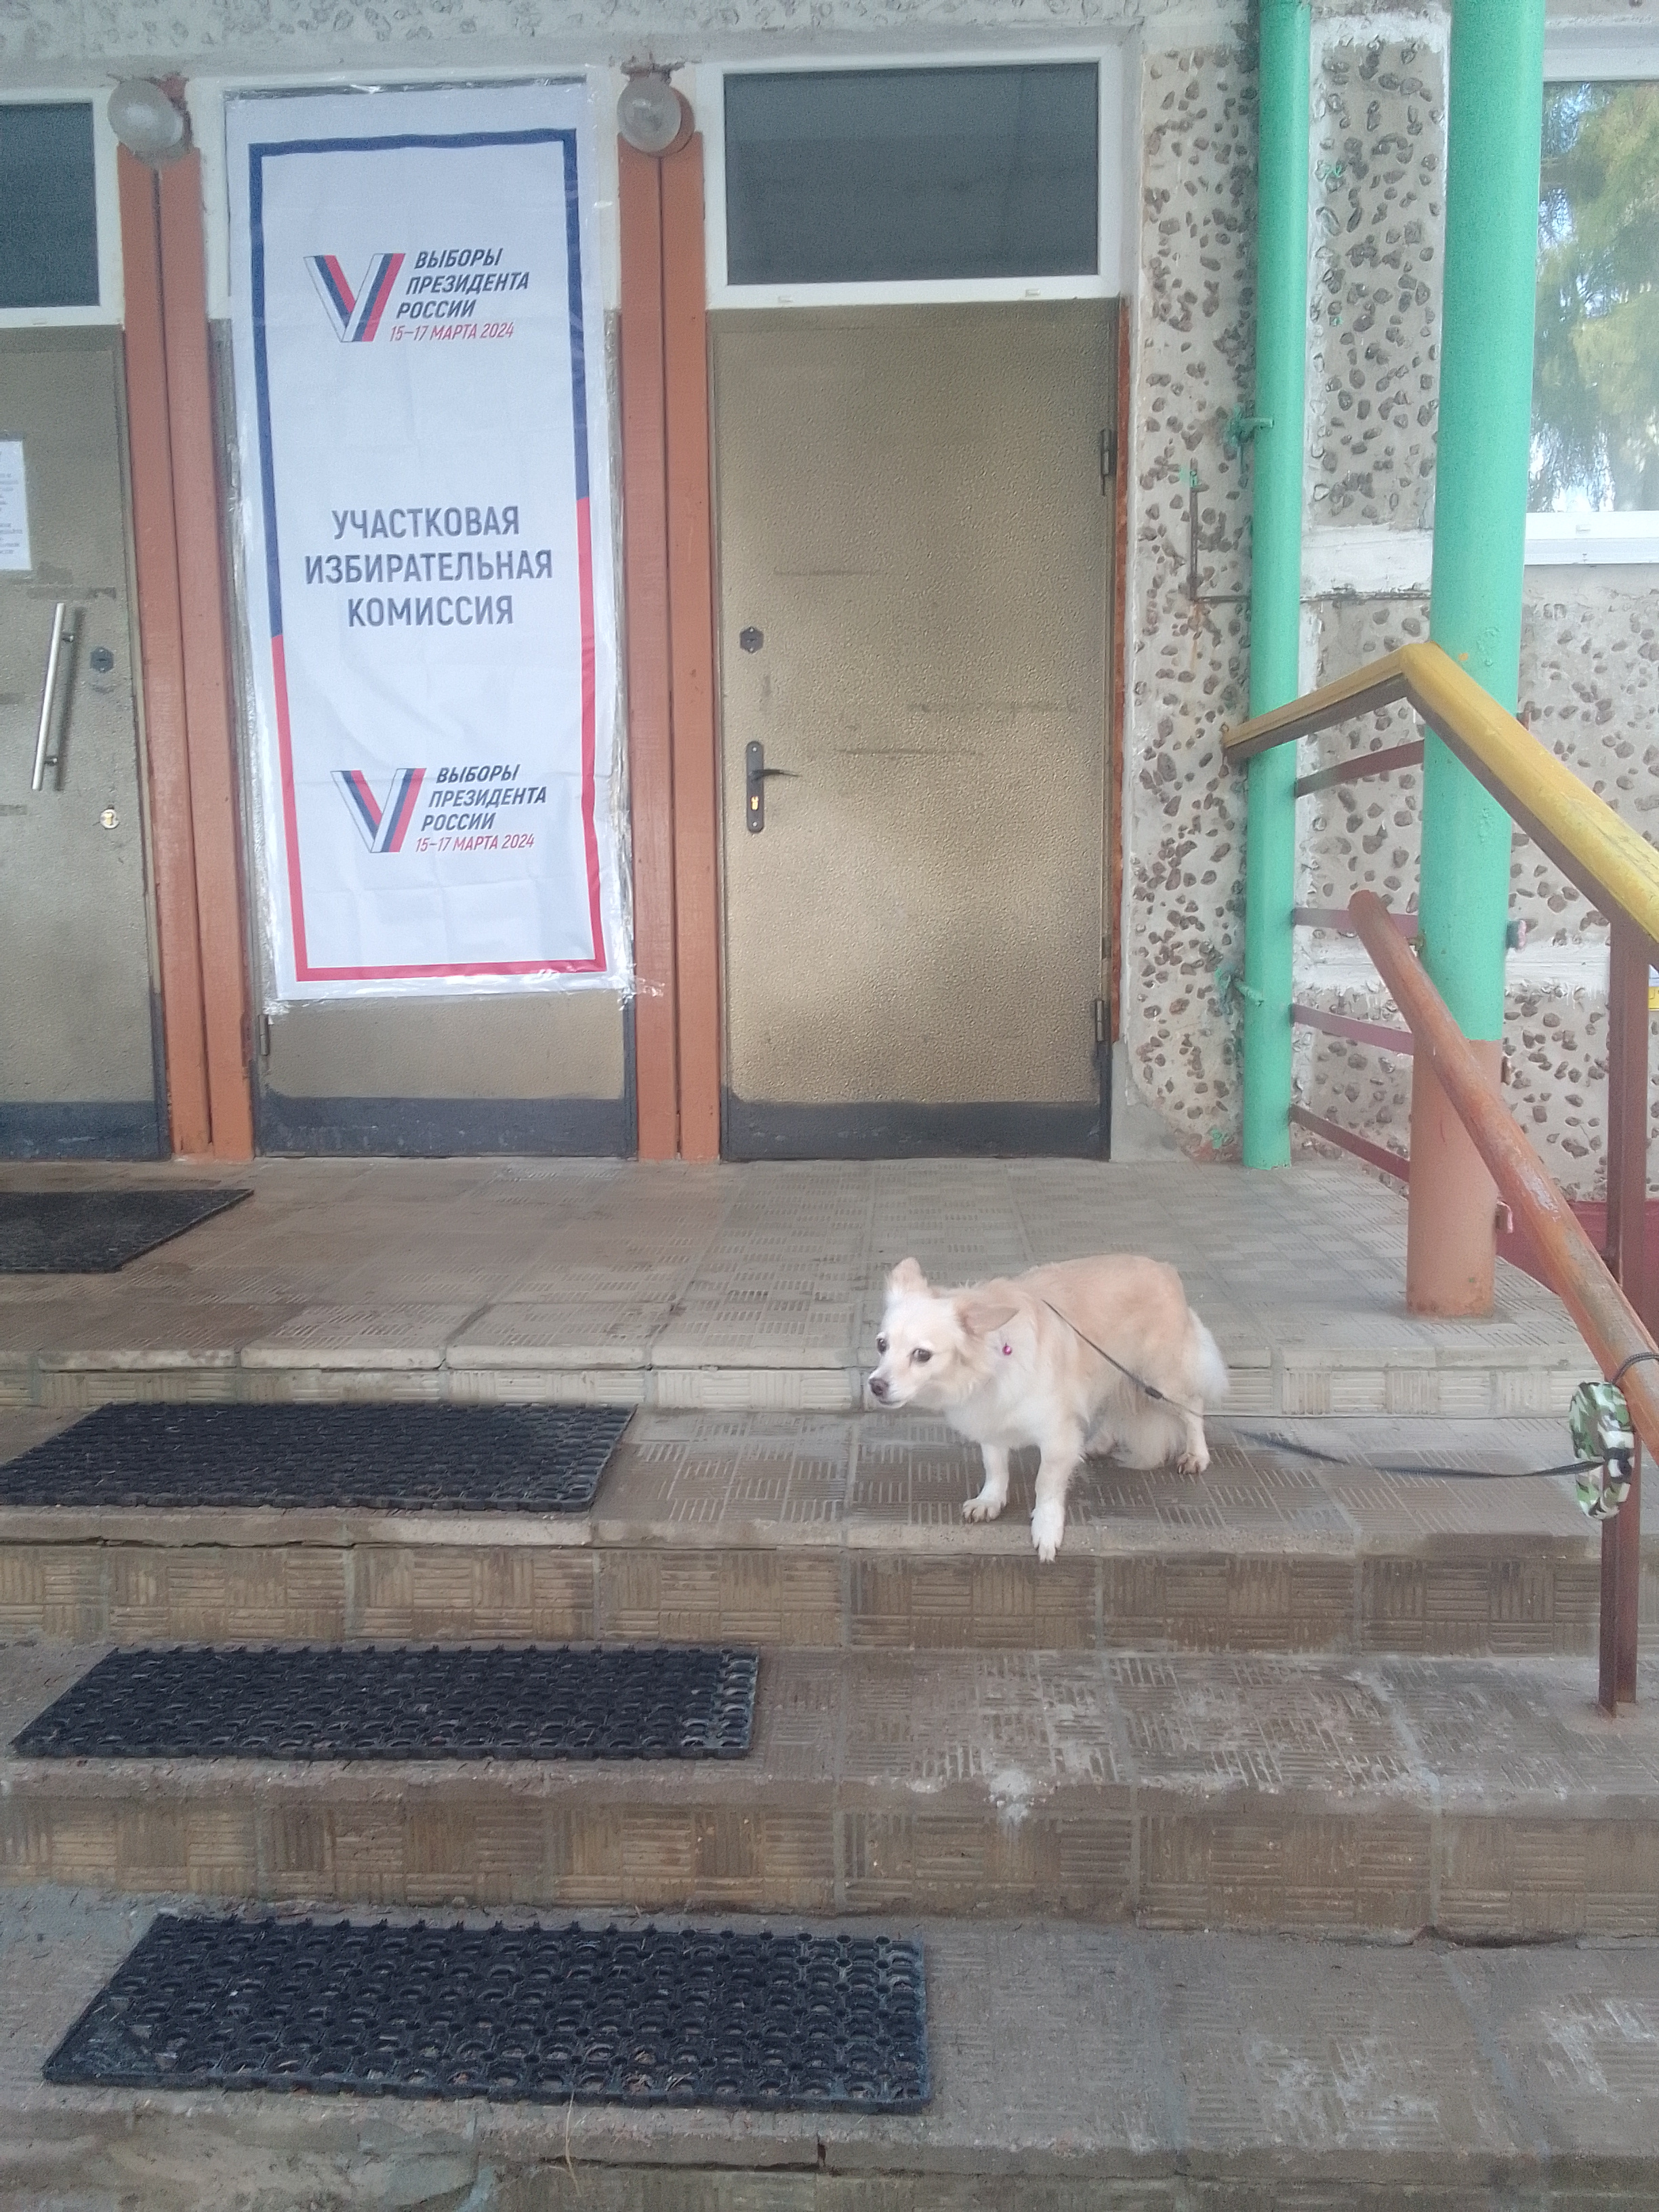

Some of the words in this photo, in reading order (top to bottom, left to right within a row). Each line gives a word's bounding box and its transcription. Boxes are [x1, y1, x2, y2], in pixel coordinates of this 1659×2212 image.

[415, 248, 504, 269] ВЫБОРЫ
[406, 272, 529, 296] ПРЕЗИДЕНТА
[304, 253, 406, 342] V
[396, 299, 476, 319] РОССИИ
[430, 323, 476, 340] МАРТА
[480, 322, 514, 339] 2024
[331, 506, 519, 540] УЧАСТКОВАЯ
[305, 550, 553, 585] ИЗБИРАТЕЛЬНАЯ
[348, 595, 514, 627] КОМИССИЯ
[436, 764, 521, 783] ВЫБОРЫ
[428, 786, 547, 808] ПРЕЗИДЕНТА
[331, 769, 426, 853] V
[421, 813, 496, 832] РОССИИ
[453, 836, 499, 851] МАРТА
[501, 834, 535, 848] 2024
